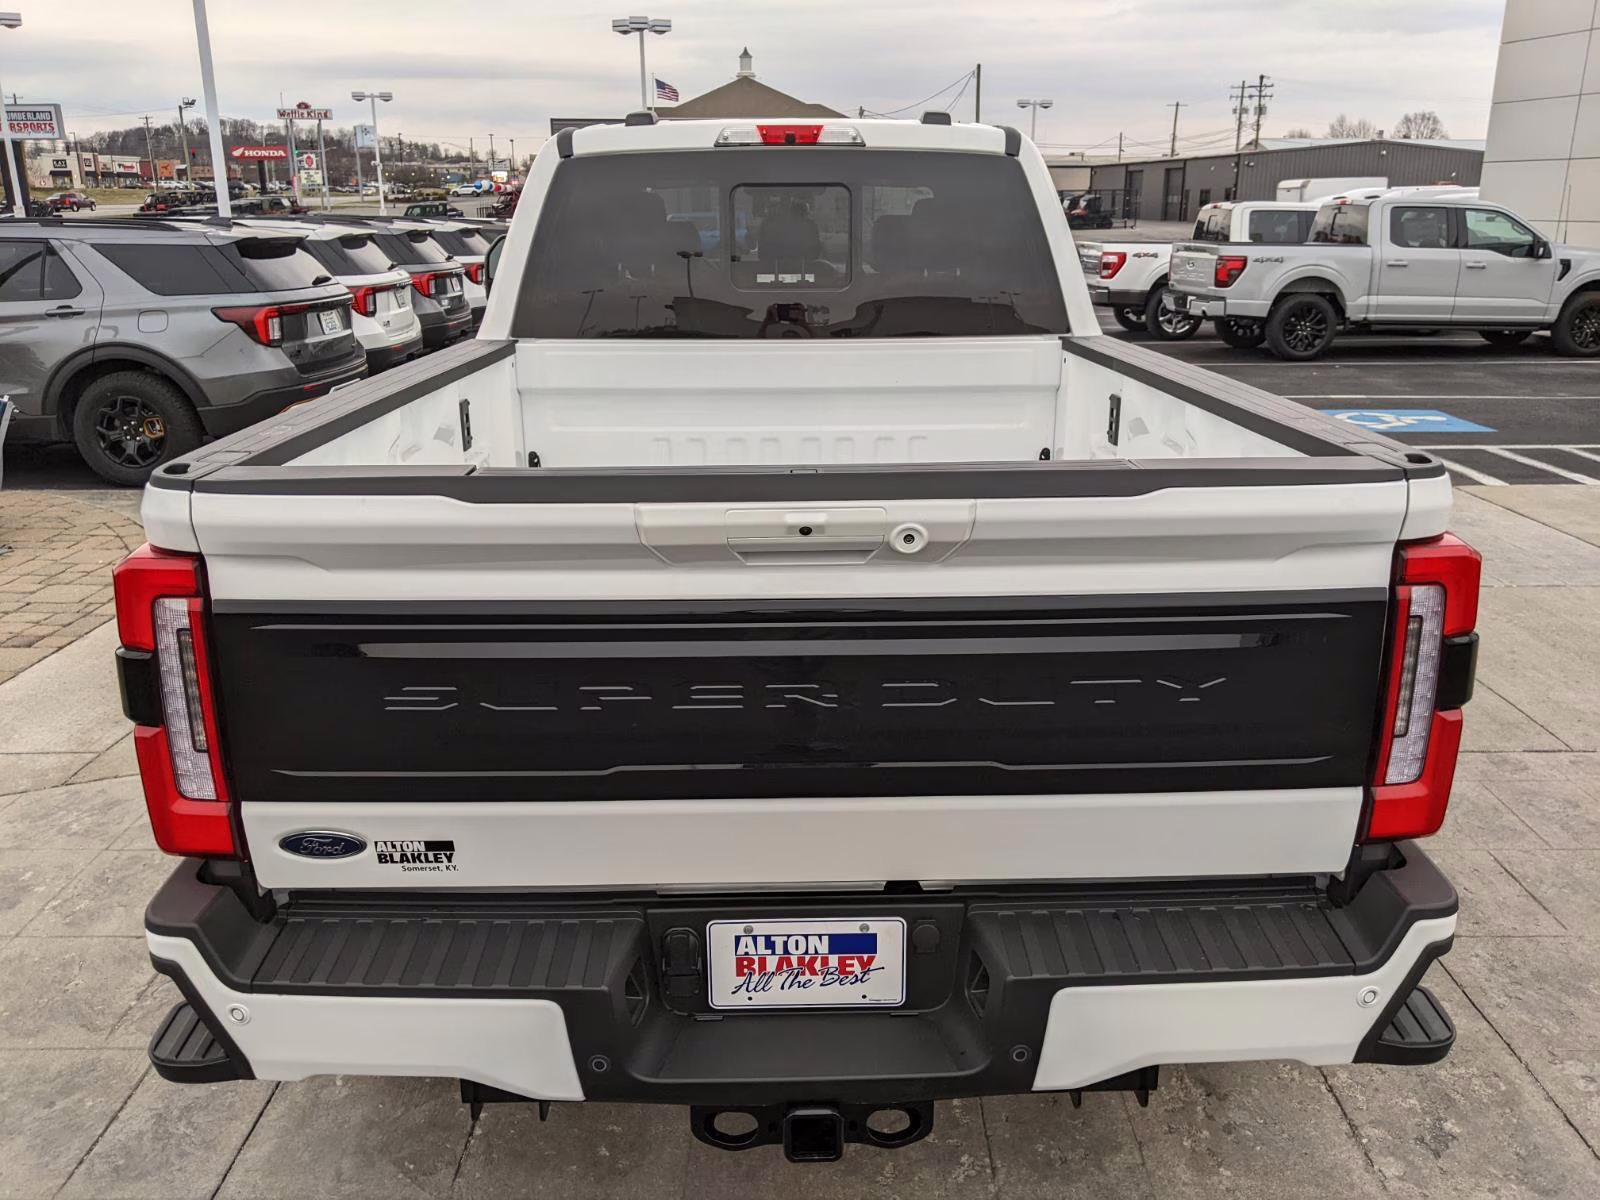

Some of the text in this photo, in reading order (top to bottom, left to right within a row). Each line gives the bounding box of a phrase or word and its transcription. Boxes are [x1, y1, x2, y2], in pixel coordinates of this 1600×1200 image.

[279, 109, 328, 119] Waffle King
[383, 676, 1229, 711] SUPER DUTY
[299, 837, 346, 855] Ford
[375, 841, 426, 852] ALTON
[377, 852, 455, 864] BLAKLEY
[401, 864, 460, 873] Somerset, KY.
[735, 935, 830, 955] ALTON
[735, 955, 877, 977] BLAKLEY
[731, 965, 885, 994] All The Best
